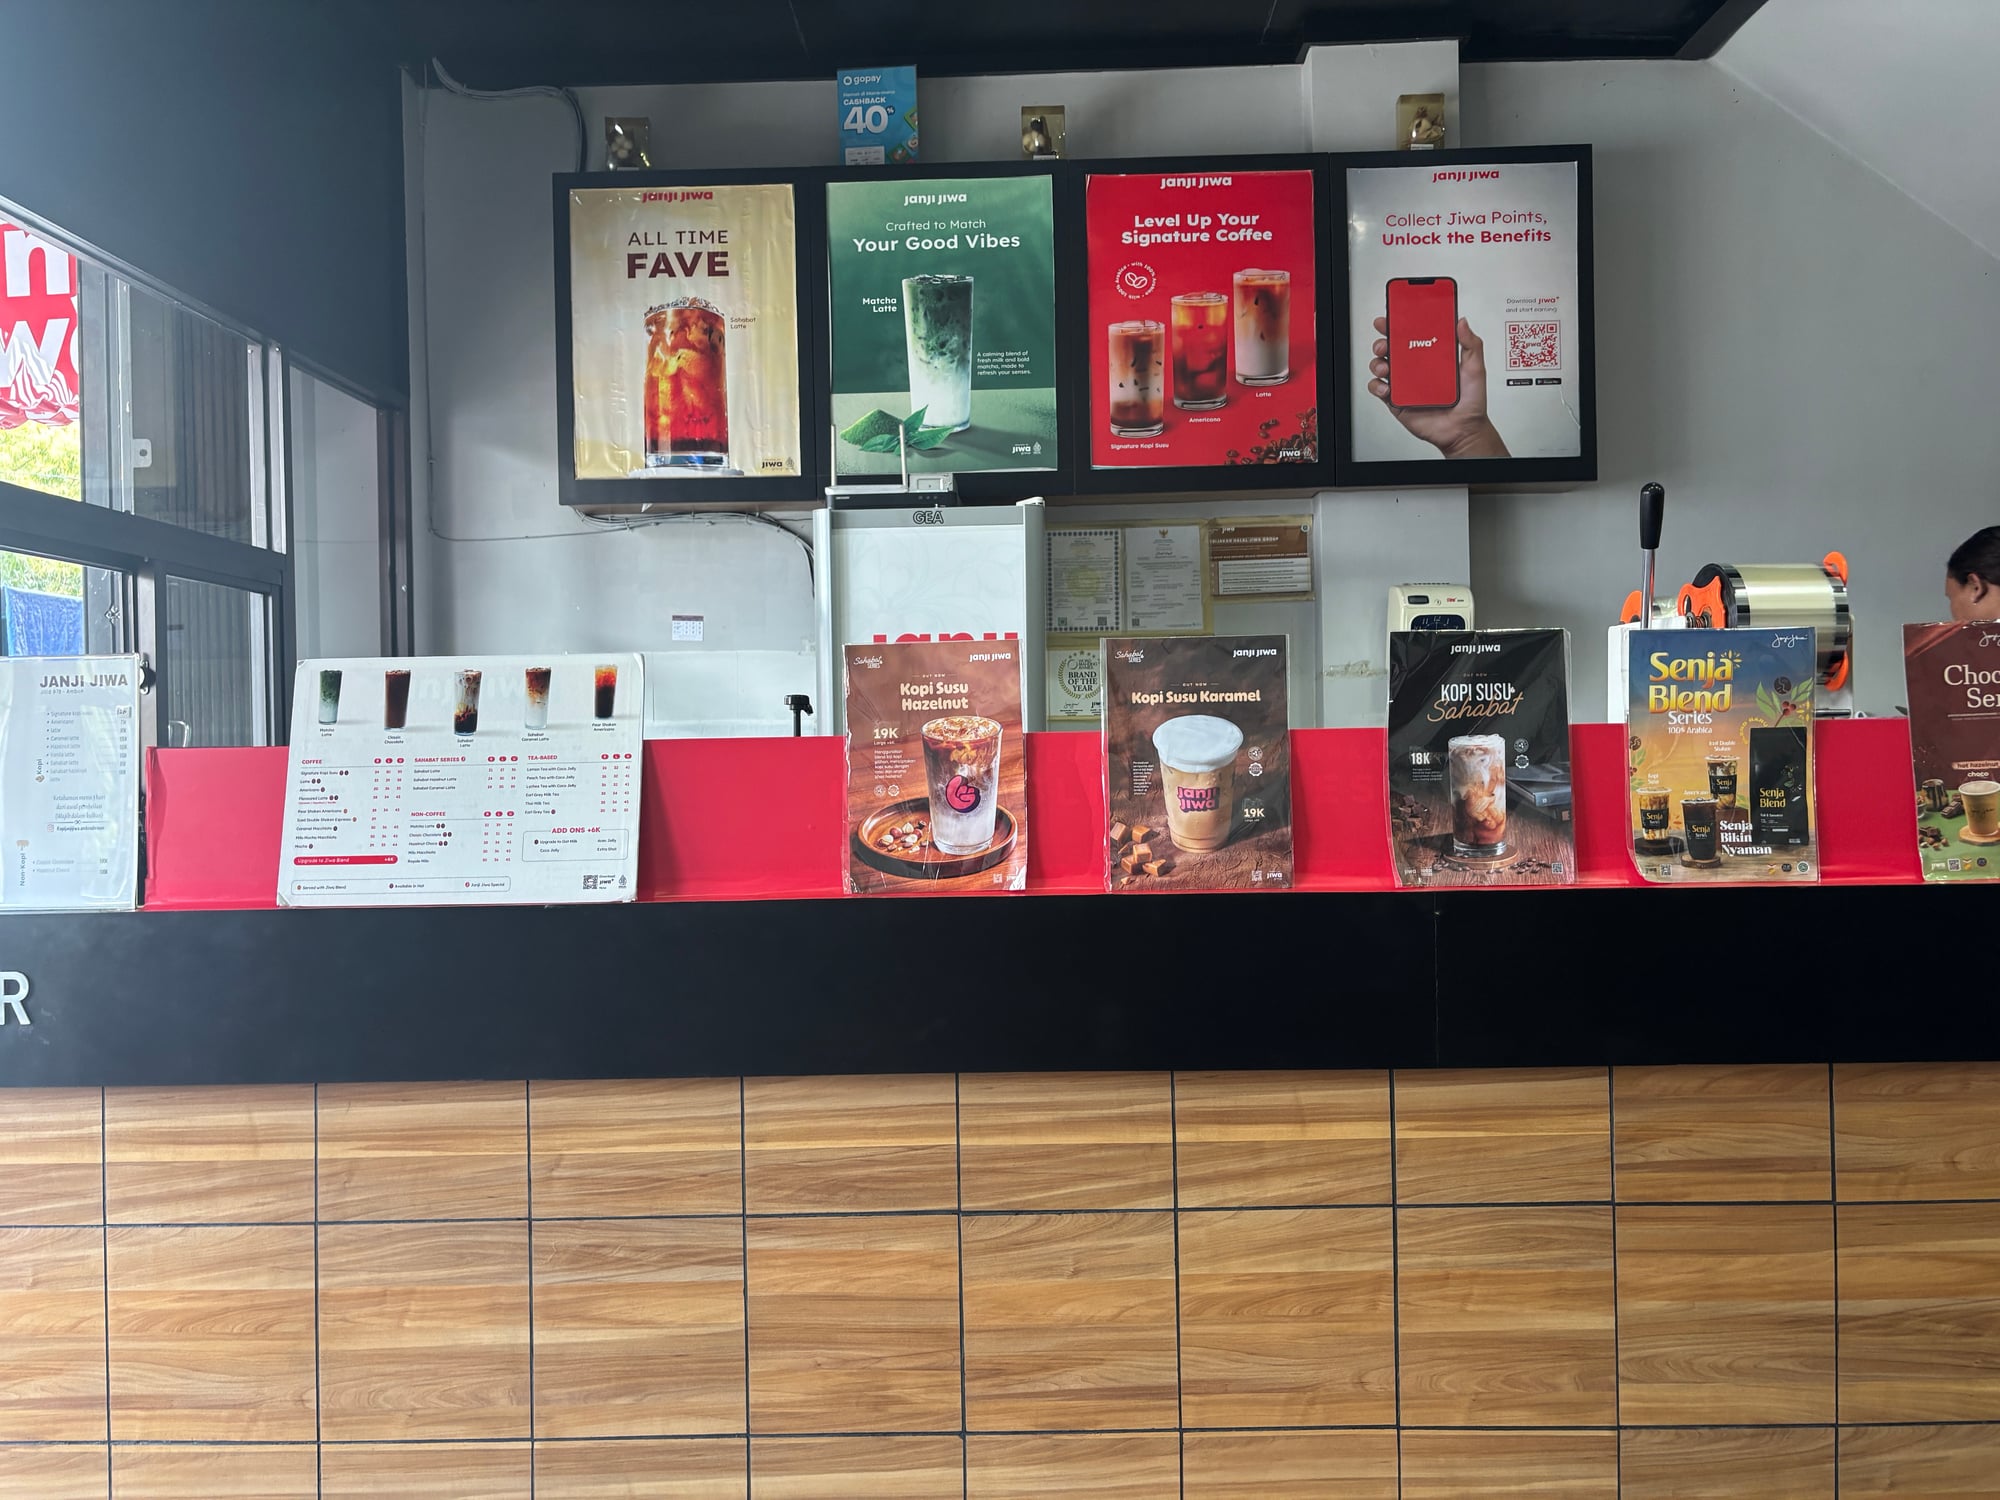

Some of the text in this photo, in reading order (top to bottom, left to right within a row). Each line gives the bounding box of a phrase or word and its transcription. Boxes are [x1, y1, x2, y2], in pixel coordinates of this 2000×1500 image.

[854, 76, 881, 85] gopay
[844, 97, 886, 106] CASHBACK
[1135, 213, 1259, 229] Level Up Your
[1385, 210, 1547, 227] Collect Jiwa Points,
[886, 219, 986, 232] Crafted to Match
[628, 230, 728, 246] ALL TIME
[853, 234, 1020, 252] Your Good Vibes
[1122, 228, 1272, 247] Signature Coffee
[1382, 229, 1552, 246] Unlock the Benefits
[627, 251, 729, 279] FAVE
[863, 297, 897, 305] Matcha
[873, 305, 897, 313] Latte
[1110, 443, 1139, 451] Signature
[912, 510, 944, 525] GEA
[1069, 671, 1097, 679] BRAND
[1649, 651, 1733, 689] Senja
[40, 674, 128, 688] JANJI JIWA
[900, 682, 969, 697] Kopi Susu
[1441, 682, 1511, 702] KOPI SUSU
[902, 697, 969, 711] Hazelnut
[1131, 689, 1261, 706] Kopi Susu Karamel
[1649, 684, 1733, 713] Blend
[1427, 692, 1524, 722] Sahabat
[1668, 711, 1713, 726] Series
[874, 728, 899, 739] 19K
[1687, 726, 1713, 734] Arabica
[1410, 752, 1431, 765] 18K
[1967, 770, 1990, 778] choco
[1759, 788, 1785, 798] Senja
[1759, 798, 1786, 808] Blend
[1243, 808, 1265, 818] 19K
[1646, 813, 1664, 821] Senja
[1692, 824, 1711, 834] Senja
[1720, 820, 1754, 832] Senja
[1720, 832, 1753, 843] Bikin
[1721, 844, 1772, 856] Nyaman
